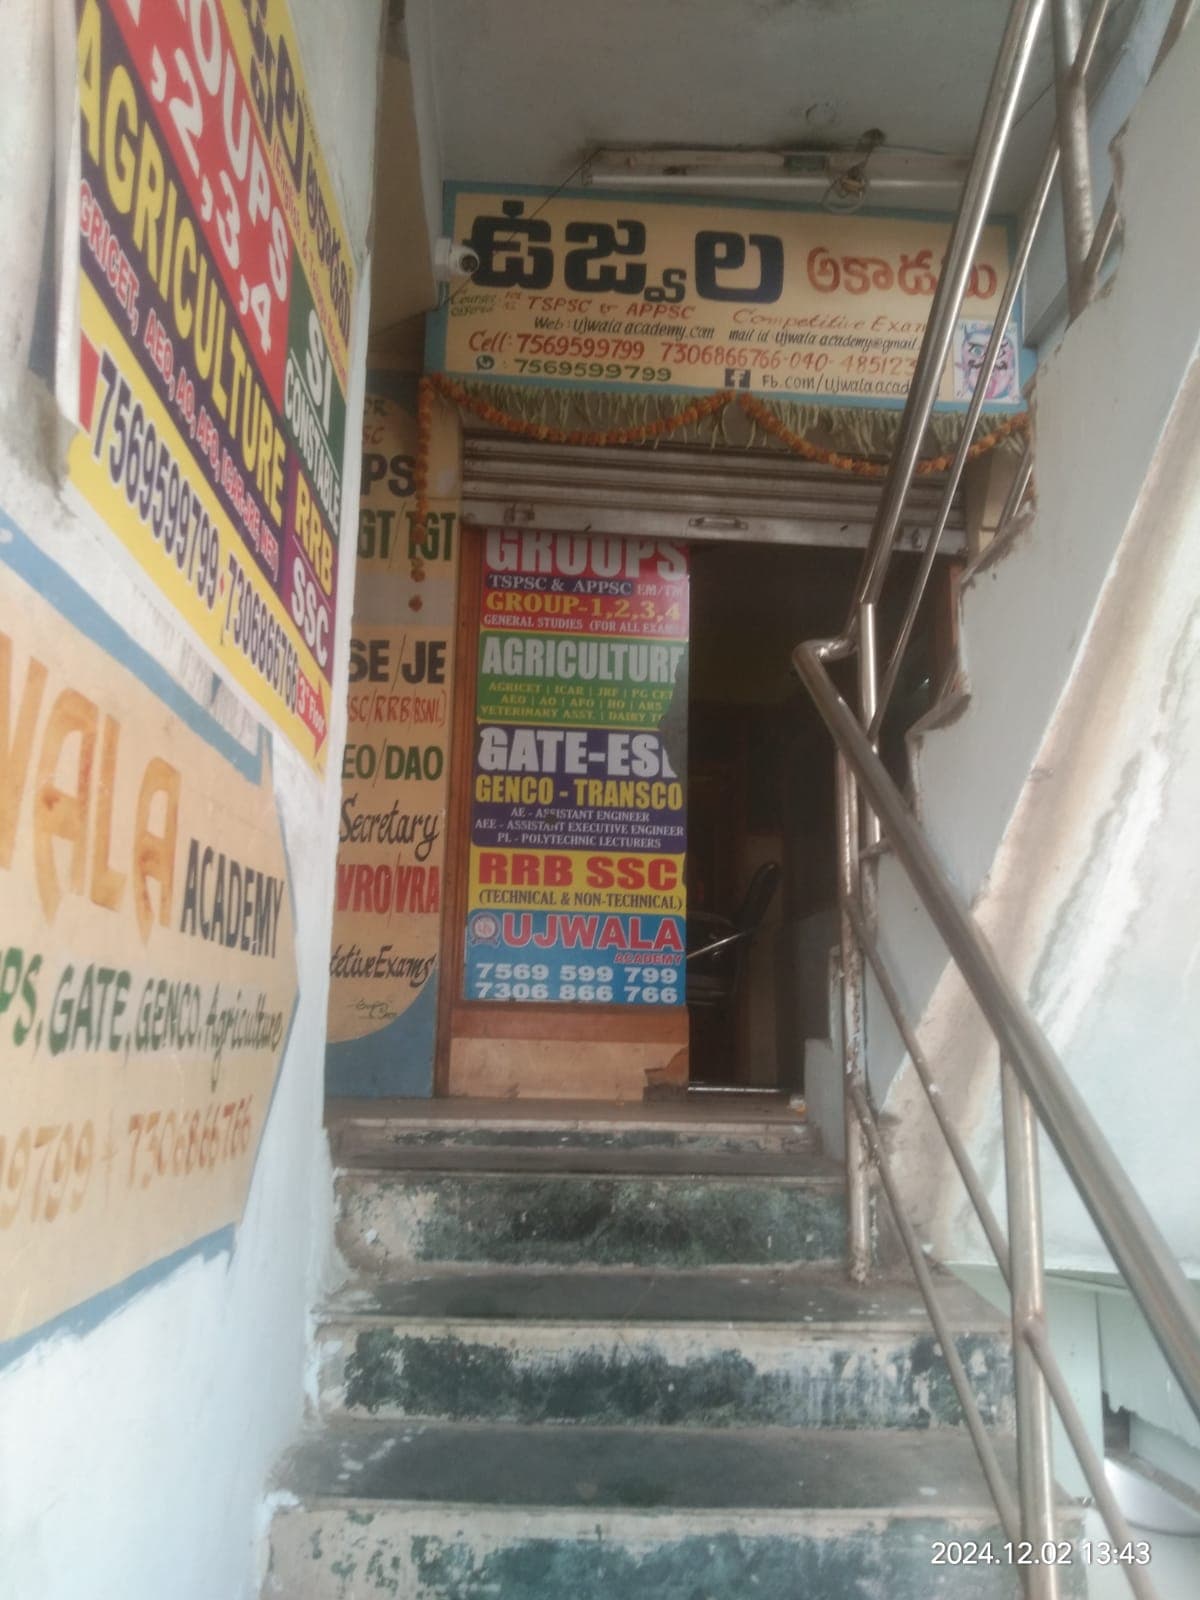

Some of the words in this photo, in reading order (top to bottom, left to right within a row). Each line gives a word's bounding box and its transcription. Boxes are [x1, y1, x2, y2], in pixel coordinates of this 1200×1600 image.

[175, 0, 289, 302] OUPS
[77, 0, 286, 528] AGRICULTURE
[79, 178, 140, 337] GRICET,
[527, 296, 592, 313] TSPSC
[626, 303, 696, 320] APPSC
[516, 334, 645, 360] 7569599799
[305, 308, 333, 437] SI
[284, 357, 341, 536] CONSTABLE
[93, 356, 220, 611] 7569599799
[295, 470, 334, 596] RRB
[485, 529, 688, 582] GROUPS
[489, 574, 548, 590] TSPSC
[550, 577, 565, 591] &
[572, 580, 633, 596] APPSC
[292, 556, 329, 668] SSC
[484, 614, 534, 627] GENERAL
[537, 617, 583, 629] STUDIES
[619, 622, 640, 633] ALL
[475, 774, 554, 805] GENCO
[574, 779, 684, 810] TRANSCO
[339, 795, 439, 862] Secretary
[475, 819, 497, 829] AEE
[507, 820, 564, 832] ASSISTANT
[568, 822, 628, 834] EXECUTIVE
[631, 825, 684, 836] ENGINEER
[510, 807, 526, 817] AE
[535, 808, 593, 820] ASSISTANT
[597, 811, 650, 822] ENGINEER
[521, 833, 596, 846] POLYTECHNIC
[599, 837, 662, 848] LECTURERS
[479, 853, 572, 888] RRB
[586, 856, 678, 891] SSC
[180, 837, 285, 959] ACADEMY
[479, 889, 556, 905] (TECHNICAL
[561, 893, 570, 904] &
[574, 895, 683, 911] NON-TECHNICAL)
[502, 912, 684, 951] UJWALA
[476, 963, 549, 980] 7569
[560, 965, 613, 982] 599
[624, 967, 678, 984] 799
[613, 952, 682, 965] ACADEMY
[475, 982, 549, 1000] 7306
[559, 984, 613, 1002] 866
[624, 986, 678, 1004] 766
[0, 1119, 96, 1231] 9799
